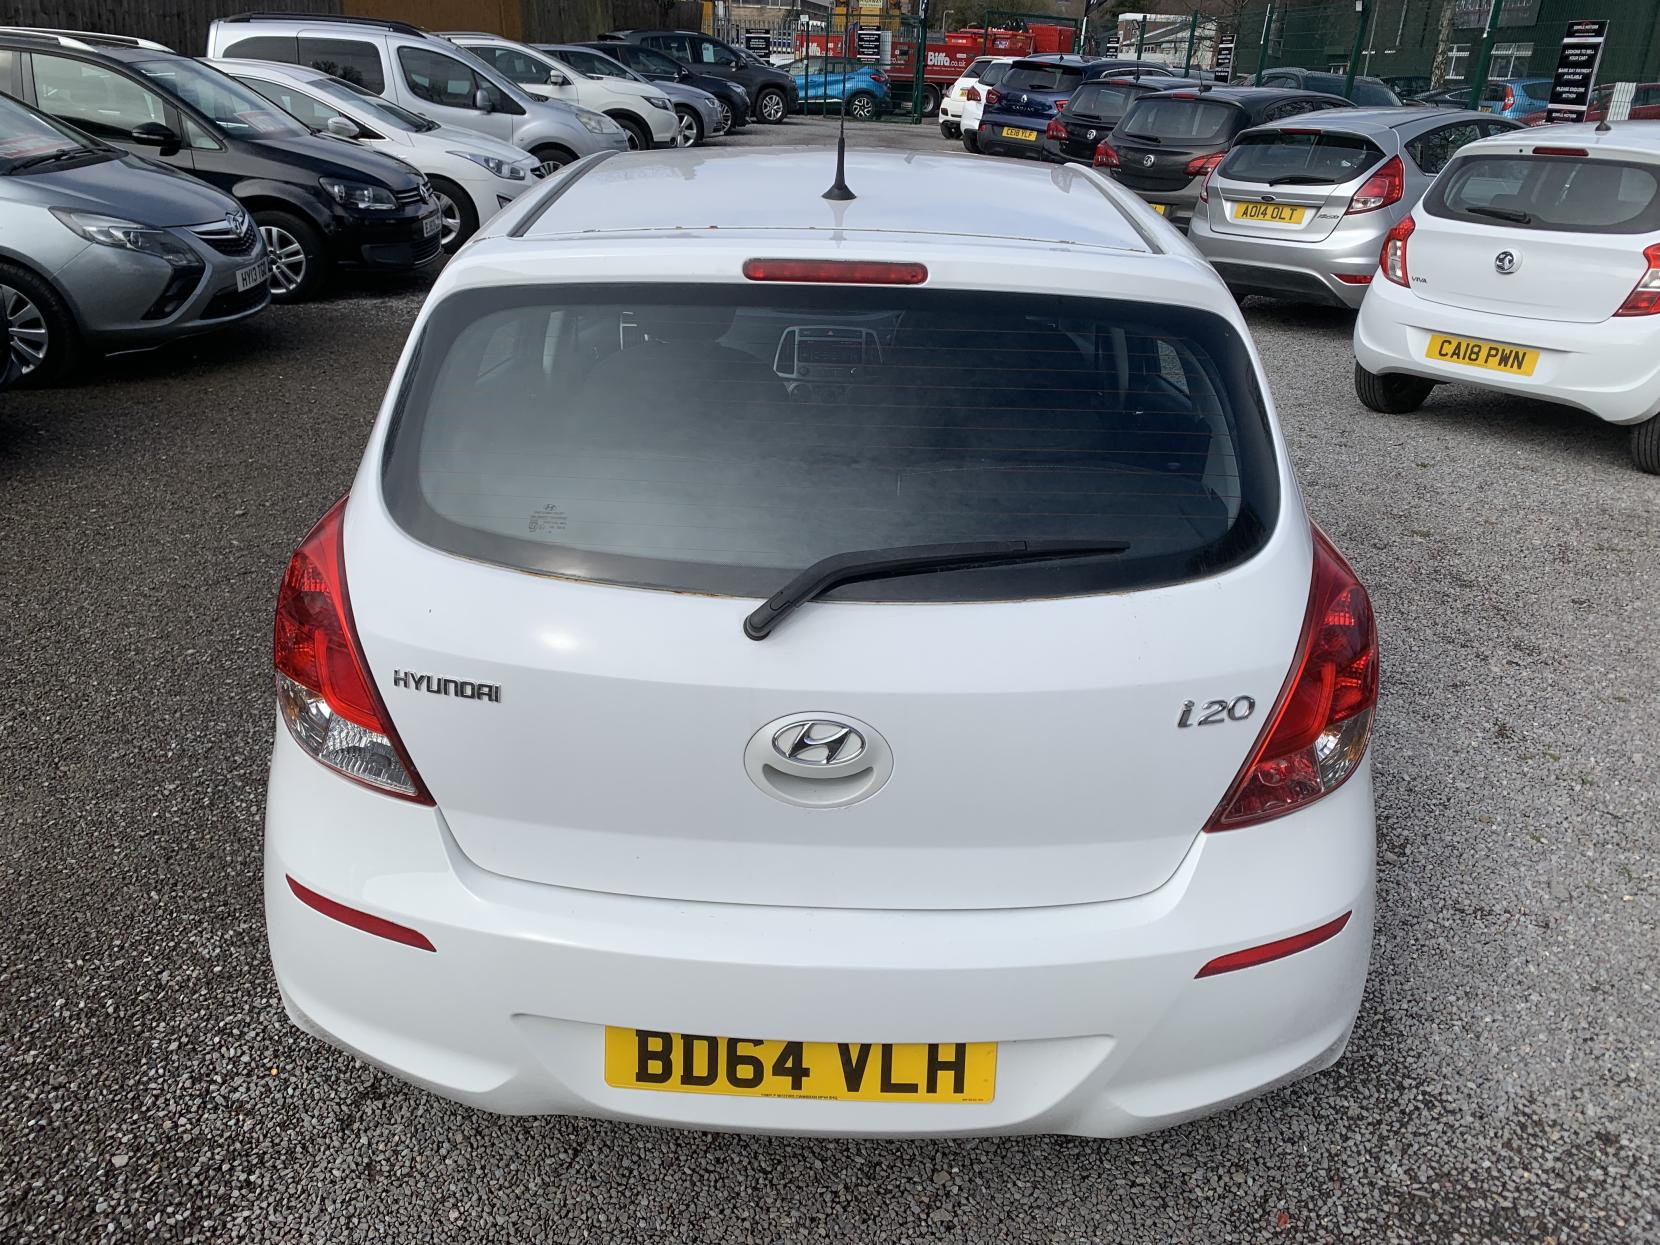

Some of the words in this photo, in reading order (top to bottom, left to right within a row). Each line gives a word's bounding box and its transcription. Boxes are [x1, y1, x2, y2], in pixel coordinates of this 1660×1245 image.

[1438, 339, 1482, 362] CA18
[1484, 346, 1527, 370] PWN
[393, 668, 502, 704] HYUNDAI
[1177, 694, 1256, 728] i20
[635, 1029, 811, 1091] BD64
[837, 1042, 967, 1094] VLH
